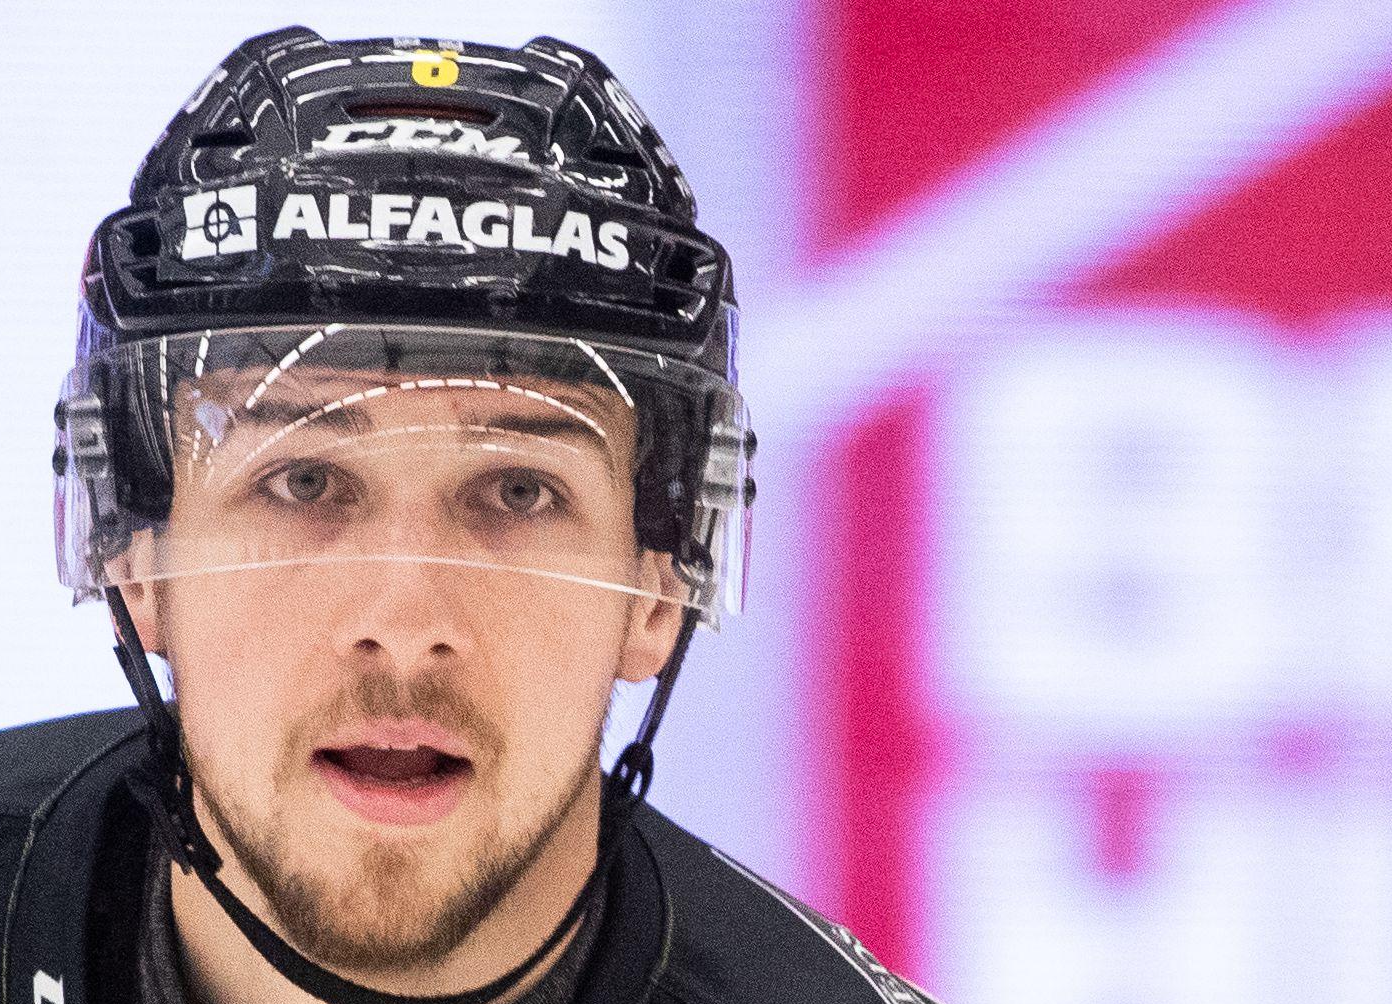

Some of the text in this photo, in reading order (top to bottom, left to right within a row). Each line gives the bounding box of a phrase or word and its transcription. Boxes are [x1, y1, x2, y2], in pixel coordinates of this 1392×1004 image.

[412, 49, 459, 87] 6
[313, 118, 531, 161] CCM
[272, 193, 630, 270] ALFAGLAS
